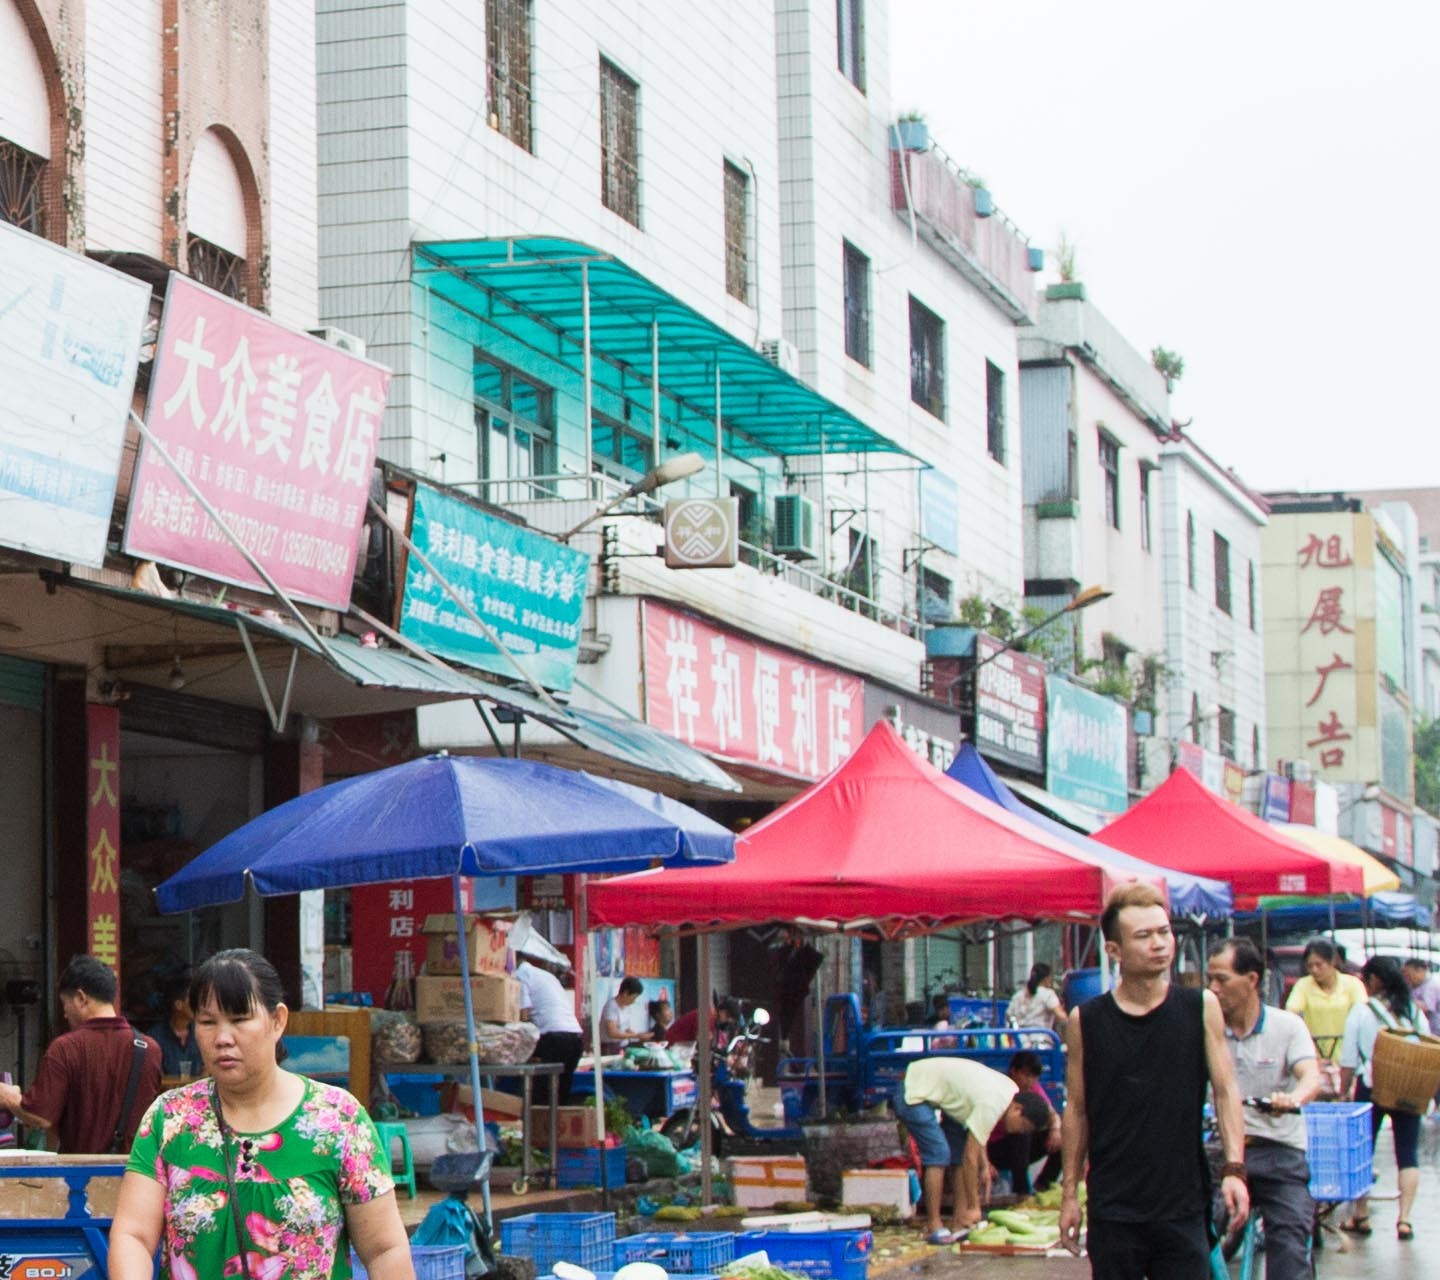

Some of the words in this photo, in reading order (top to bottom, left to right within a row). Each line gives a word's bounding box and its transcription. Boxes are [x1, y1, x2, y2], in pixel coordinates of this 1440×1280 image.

[164, 316, 382, 488] 大众美食店
[665, 615, 851, 777] 祥和便利店
[1297, 532, 1353, 770] 旭展广告
[26, 1267, 72, 1278] BOJI
